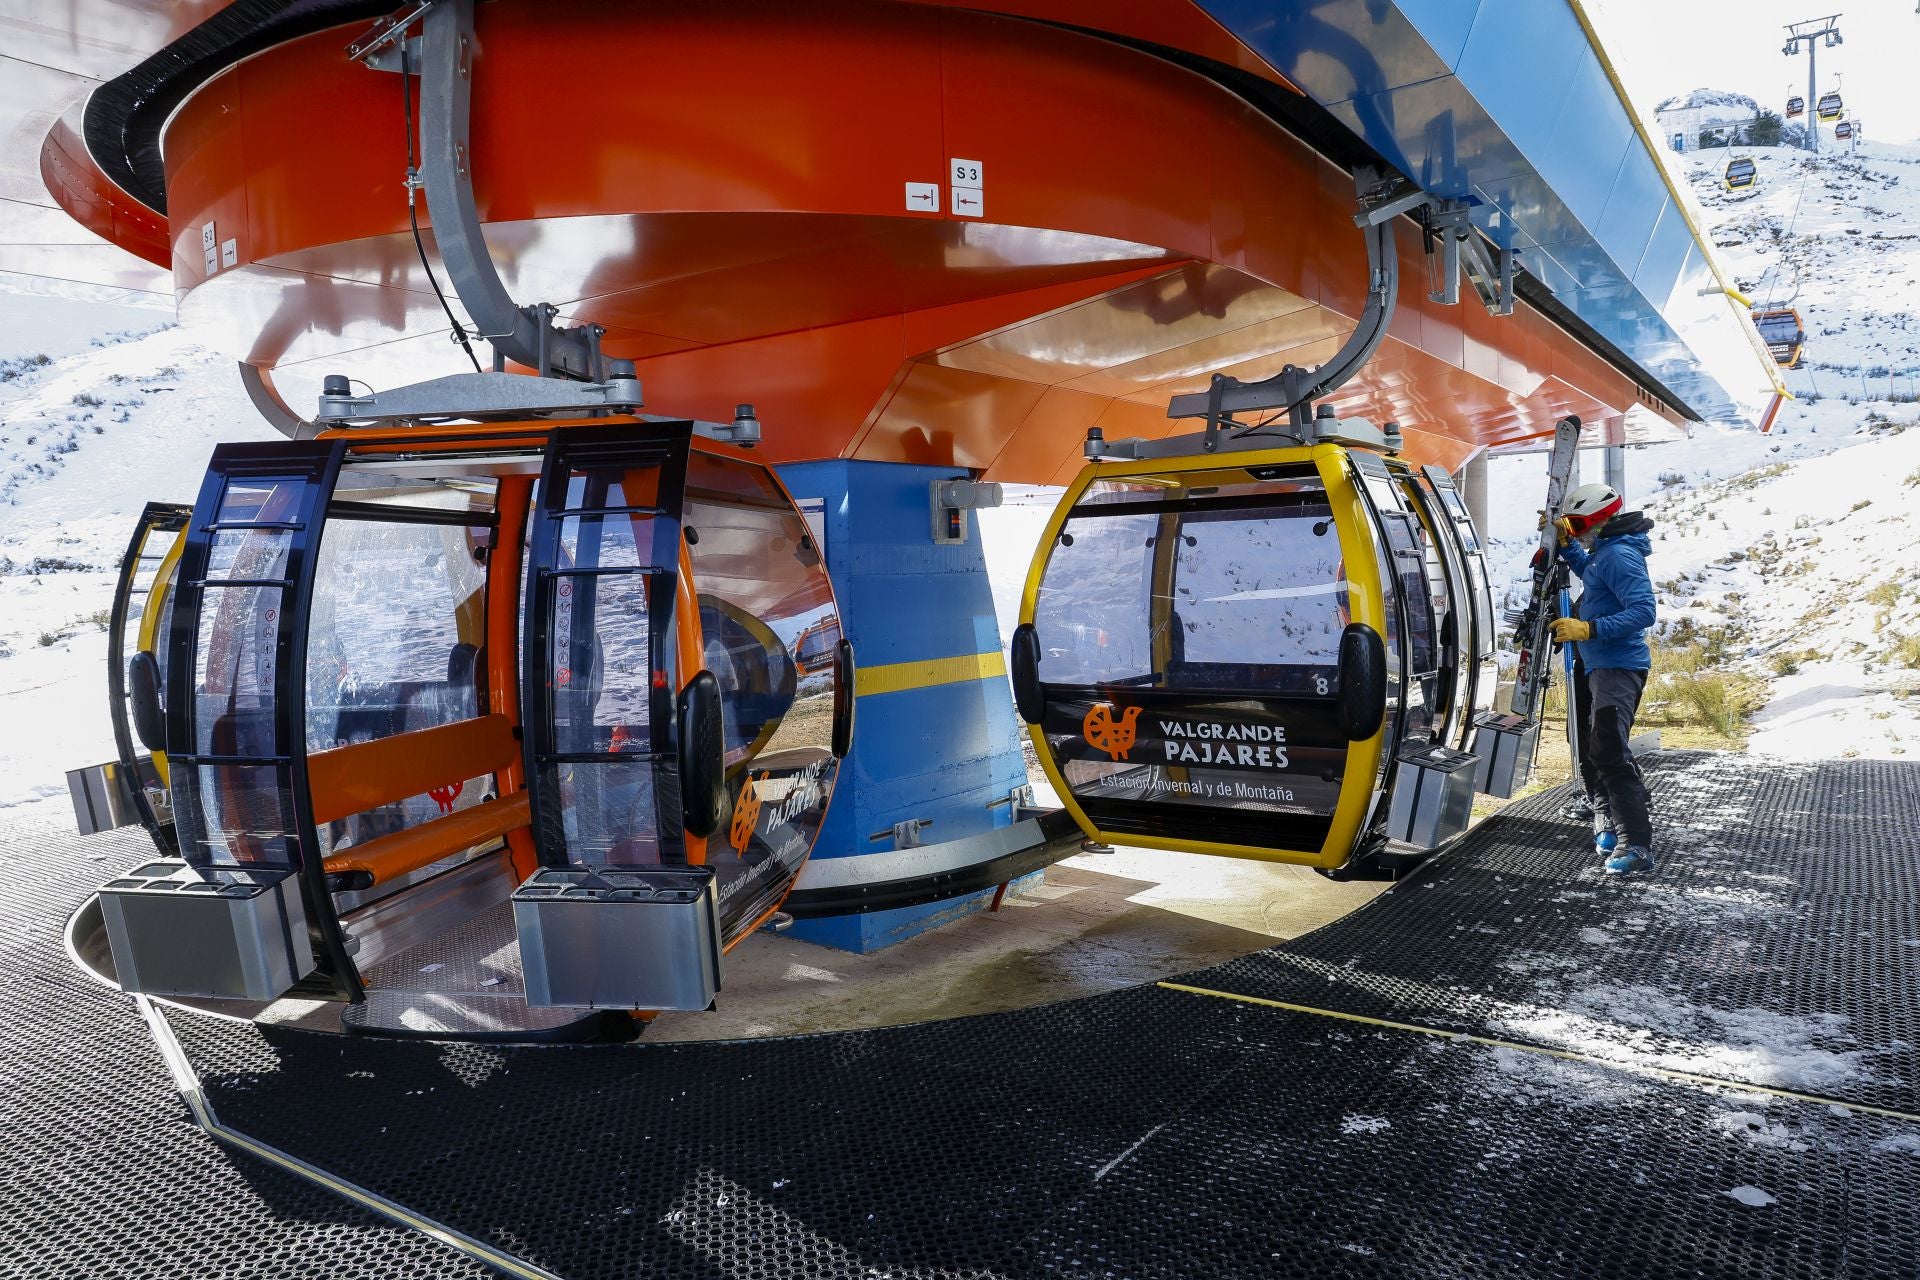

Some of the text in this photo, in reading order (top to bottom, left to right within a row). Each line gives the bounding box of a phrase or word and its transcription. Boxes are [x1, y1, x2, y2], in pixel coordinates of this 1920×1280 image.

[1316, 677, 1329, 696] 8
[1159, 720, 1286, 743] VALGRANDE
[1164, 740, 1289, 769] PAJARES
[1100, 774, 1150, 790] Estación
[1206, 783, 1213, 798] y
[1216, 781, 1232, 797] de
[1234, 782, 1294, 801] Montaña
